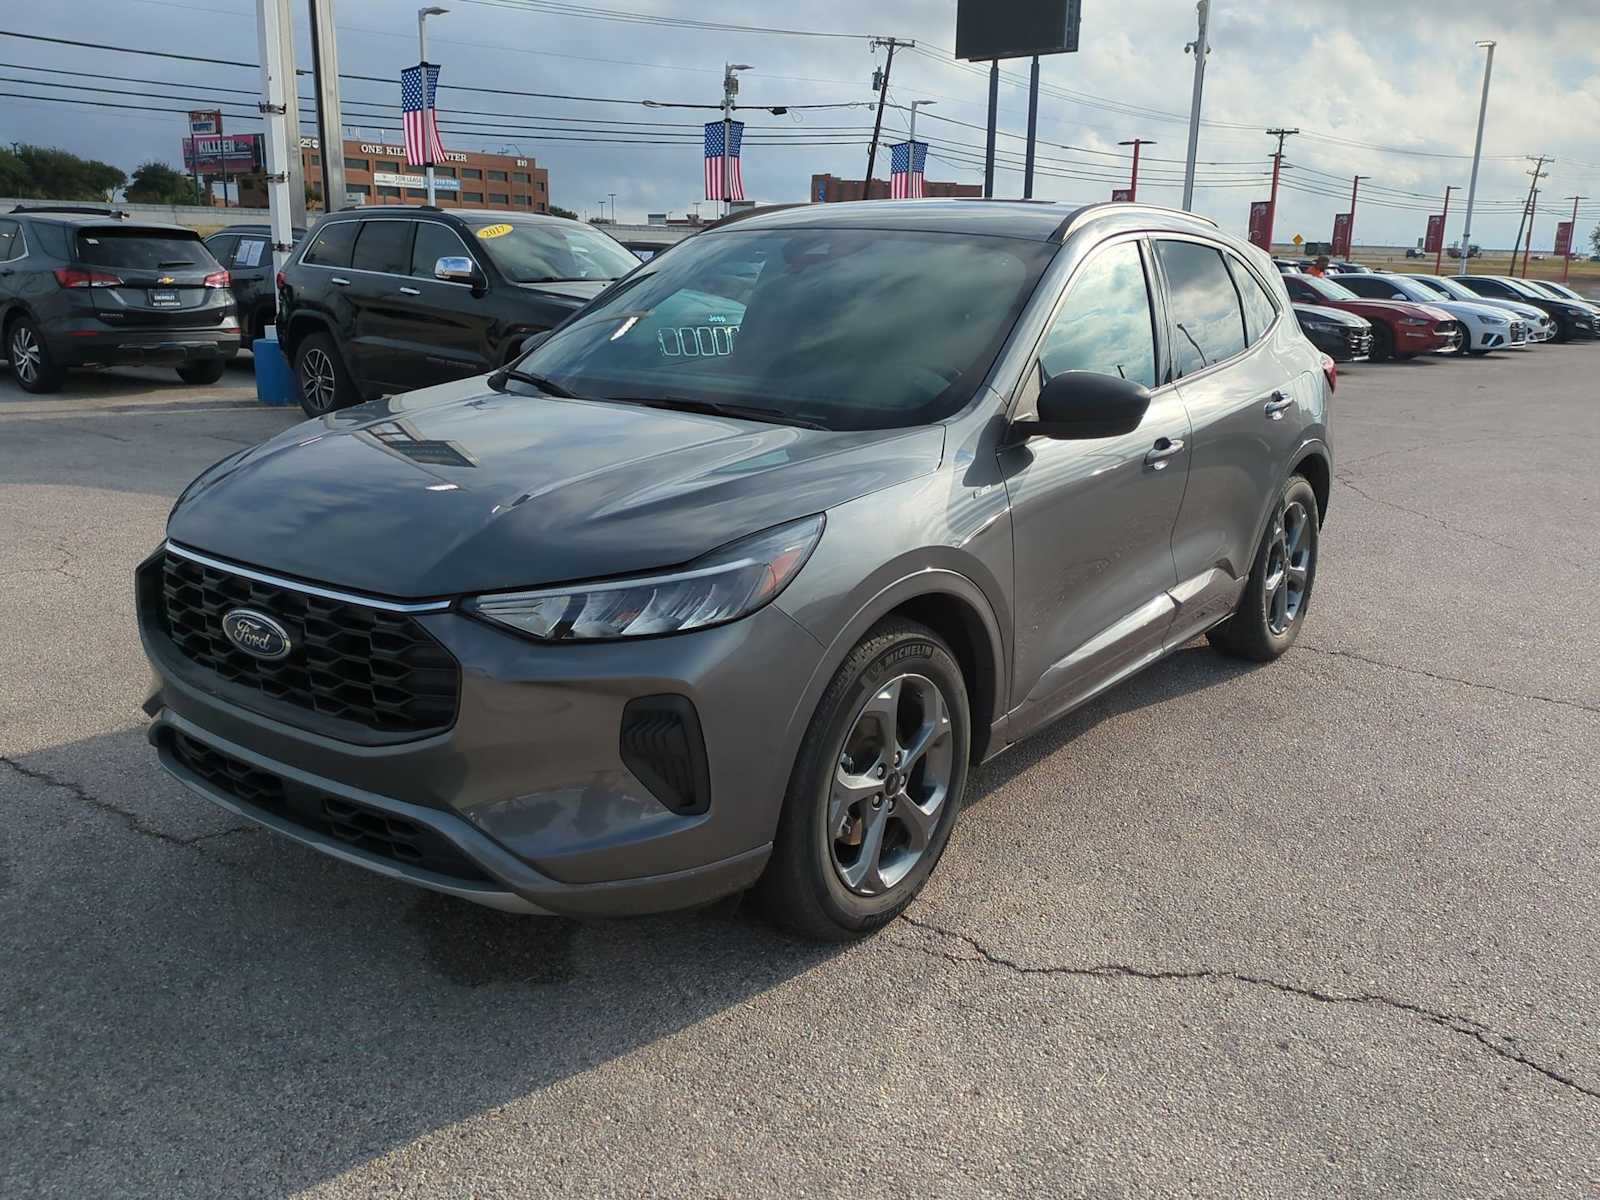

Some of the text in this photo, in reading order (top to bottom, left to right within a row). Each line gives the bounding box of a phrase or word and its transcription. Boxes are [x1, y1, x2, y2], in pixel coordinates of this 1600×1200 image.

[361, 144, 467, 162] ONE KILL NTER
[484, 225, 505, 237] 2017
[233, 619, 270, 650] Ford
[886, 644, 933, 665] MICHELIN
